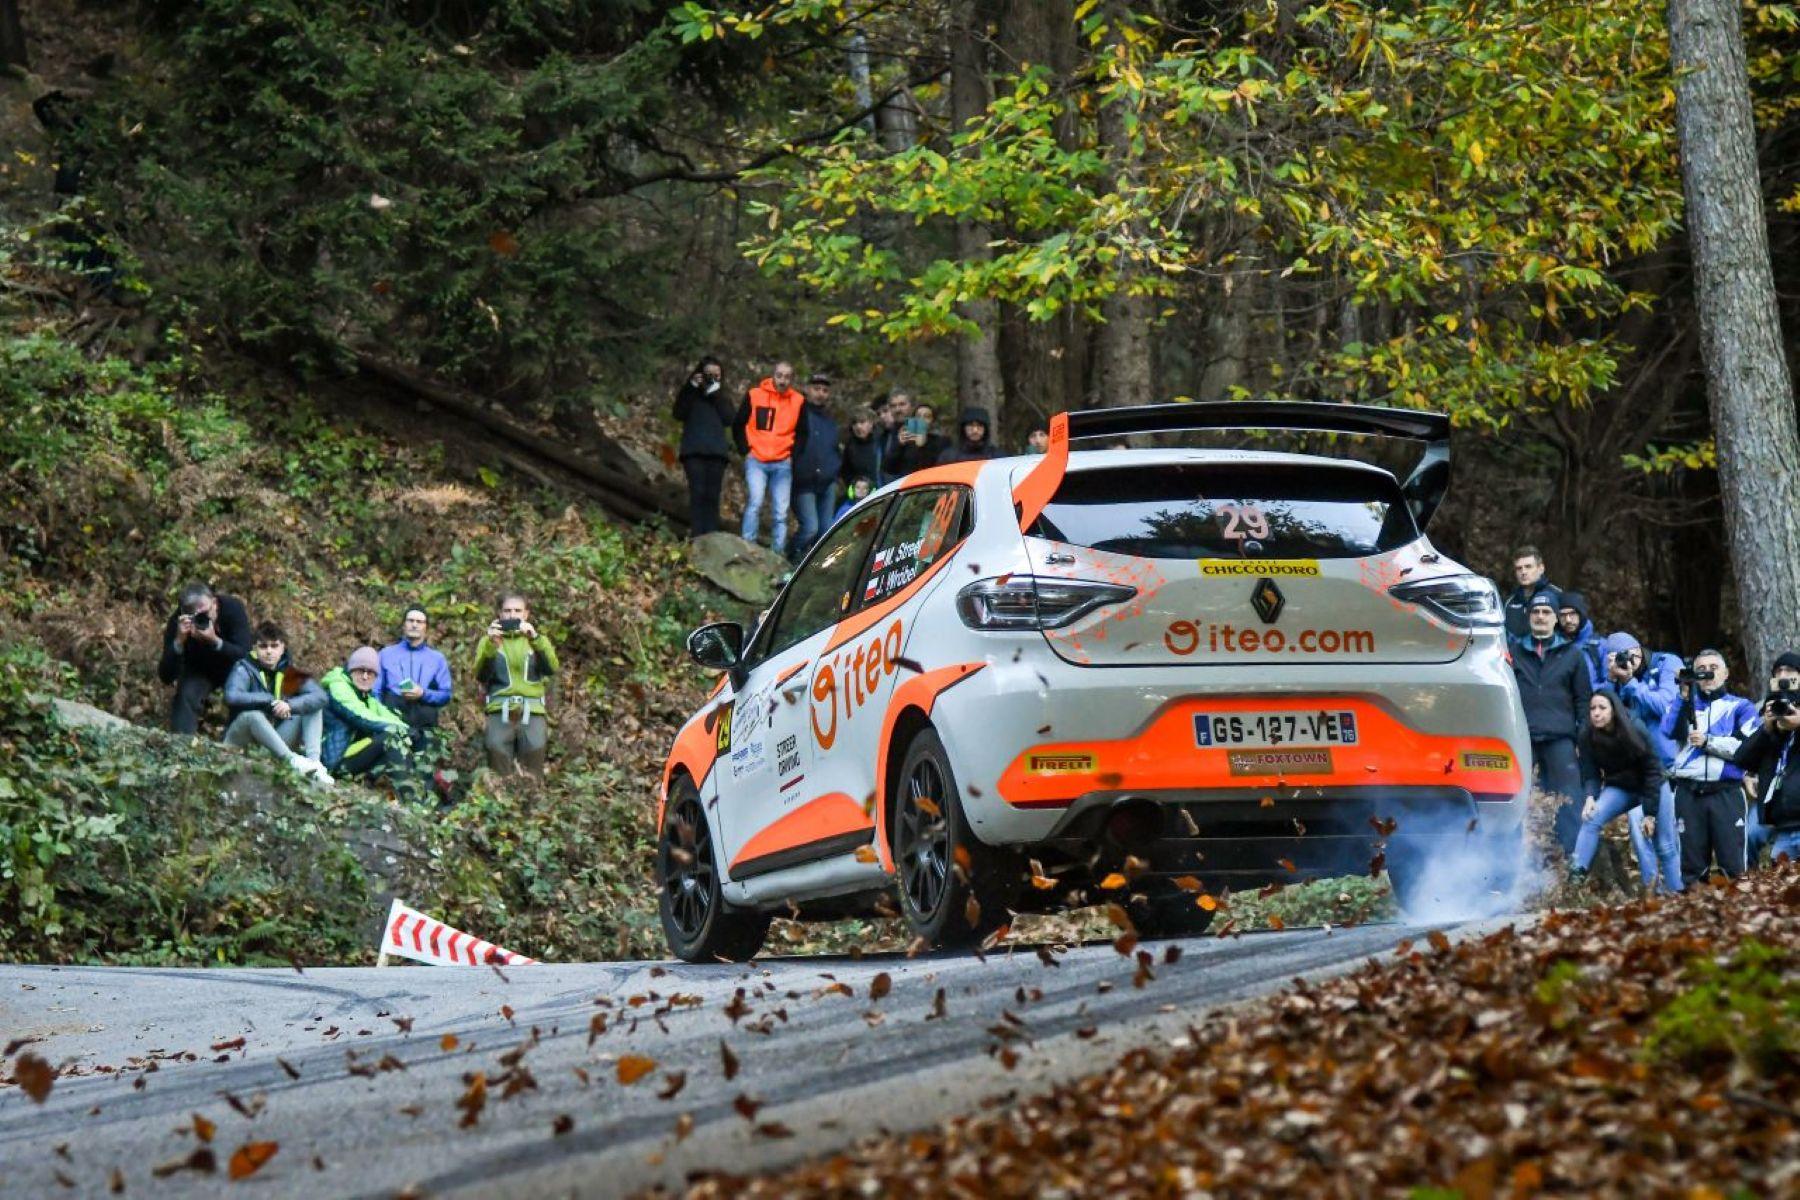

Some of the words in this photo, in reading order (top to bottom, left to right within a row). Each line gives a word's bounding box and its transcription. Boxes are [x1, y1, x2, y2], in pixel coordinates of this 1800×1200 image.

[1216, 504, 1269, 540] 29
[1208, 623, 1375, 653] iteo.com
[844, 618, 902, 721] iteo
[1212, 714, 1339, 743] GS-127-VE
[1031, 756, 1092, 770] PIRELLI
[1257, 752, 1328, 765] FOXTOWN
[1464, 753, 1508, 769] PIRELLI
